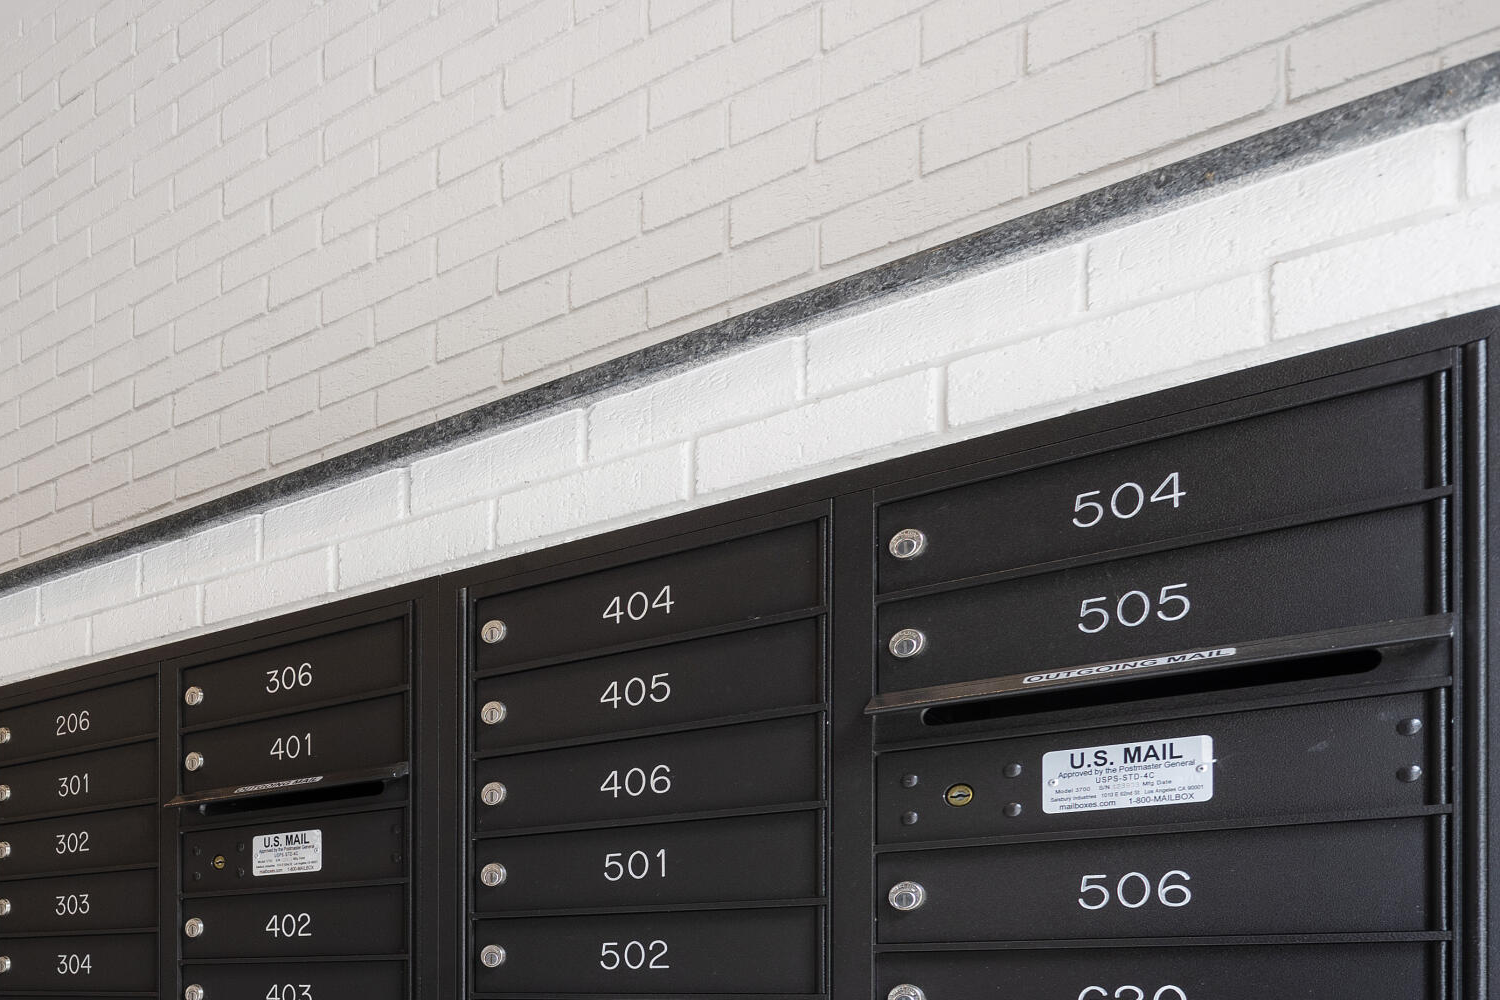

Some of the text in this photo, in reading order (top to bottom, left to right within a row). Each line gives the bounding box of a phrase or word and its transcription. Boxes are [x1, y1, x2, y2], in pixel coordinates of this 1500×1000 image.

[1072, 471, 1187, 528] 504
[602, 585, 675, 624] 404
[1077, 582, 1191, 634] 505
[265, 662, 313, 694] 306
[1026, 650, 1229, 683] OUTGOING MAIL
[600, 672, 671, 709] 405
[56, 710, 90, 736] 206
[269, 732, 311, 761] 401
[1070, 742, 1183, 769] U.S. MAIL
[600, 764, 671, 798] 406
[1058, 768, 1093, 779] Approved
[1094, 768, 1104, 776] by
[1118, 763, 1162, 773] Postmaster
[1164, 759, 1196, 768] General
[1095, 772, 1155, 784] USPS-STD-4C
[58, 773, 89, 797] 301
[1059, 793, 1195, 810] mailboxes.com 1-800-MAILBOX
[55, 831, 90, 855] 302
[263, 833, 310, 848] U.S. MAIL
[603, 848, 666, 882] 501
[1078, 869, 1192, 910] 506
[55, 893, 90, 916] 303
[265, 912, 312, 938] 402
[57, 954, 92, 975] 304
[600, 939, 670, 970] 502
